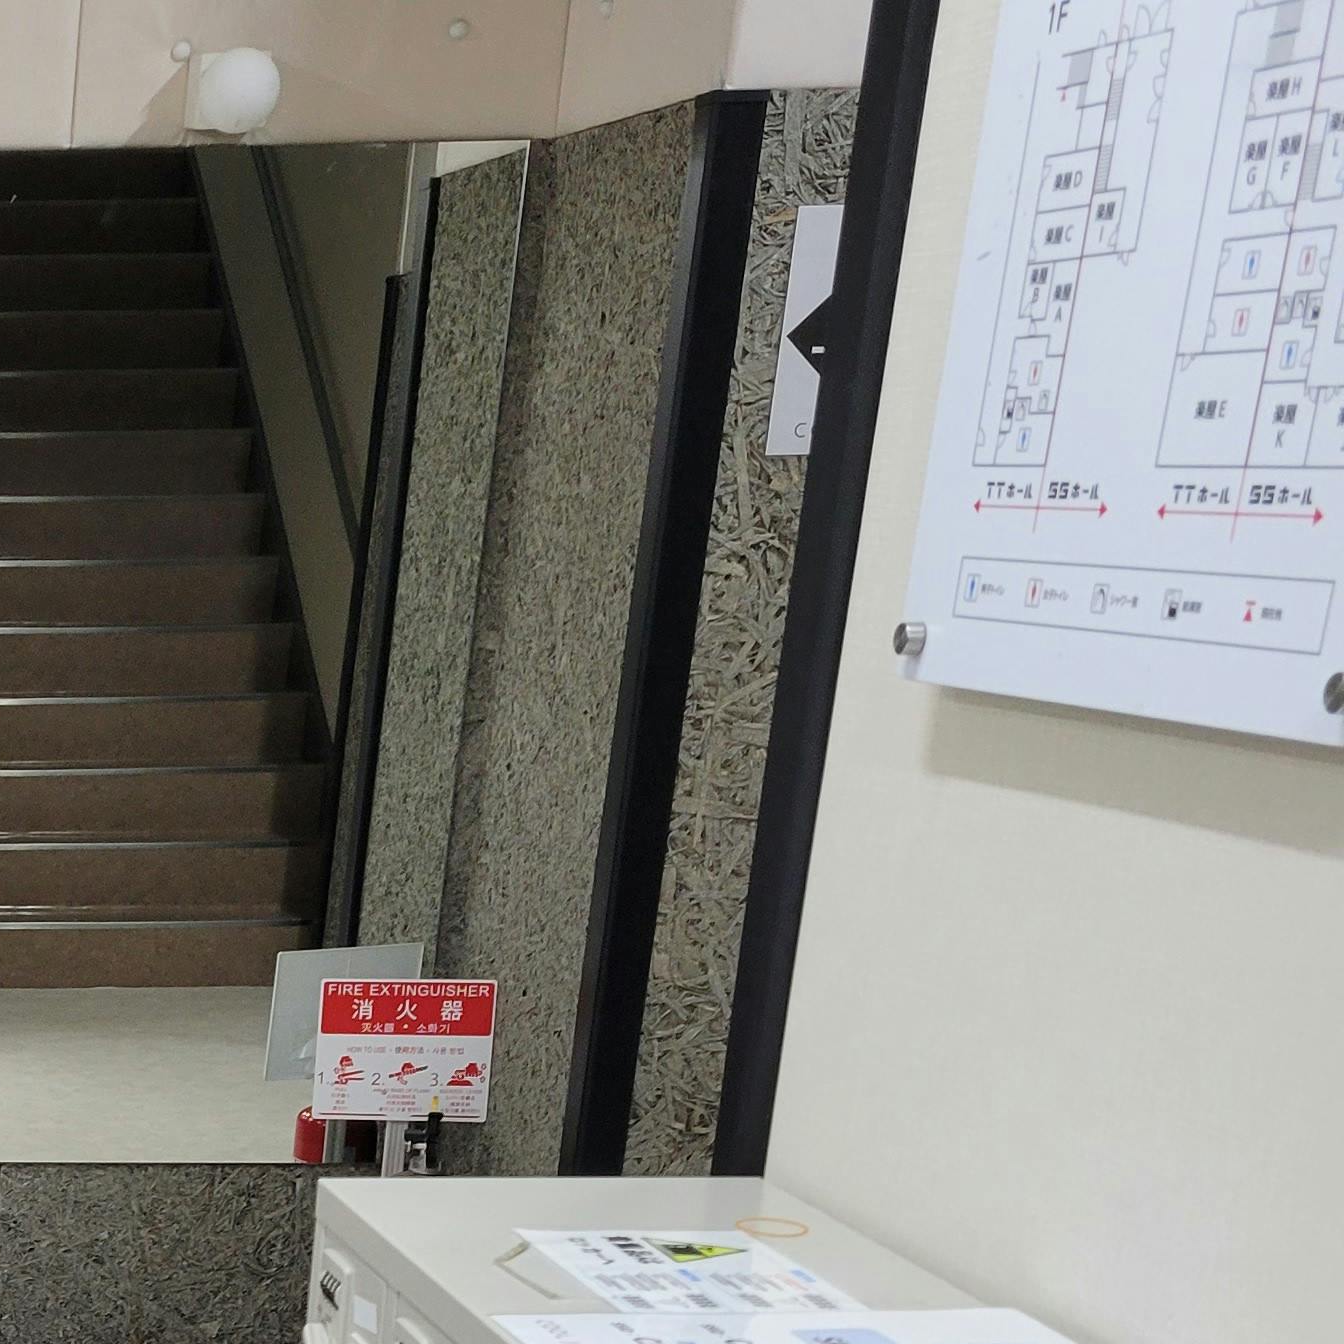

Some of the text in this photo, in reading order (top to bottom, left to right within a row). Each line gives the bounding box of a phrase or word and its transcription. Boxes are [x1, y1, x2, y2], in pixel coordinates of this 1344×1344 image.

[986, 481, 1033, 500] TTホール
[1047, 481, 1100, 500] SSホール
[1172, 484, 1230, 505] TTホール
[1247, 484, 1313, 506] SSホール
[327, 983, 490, 998] FIRE EXTINGUISHER
[351, 998, 464, 1022] 消火器
